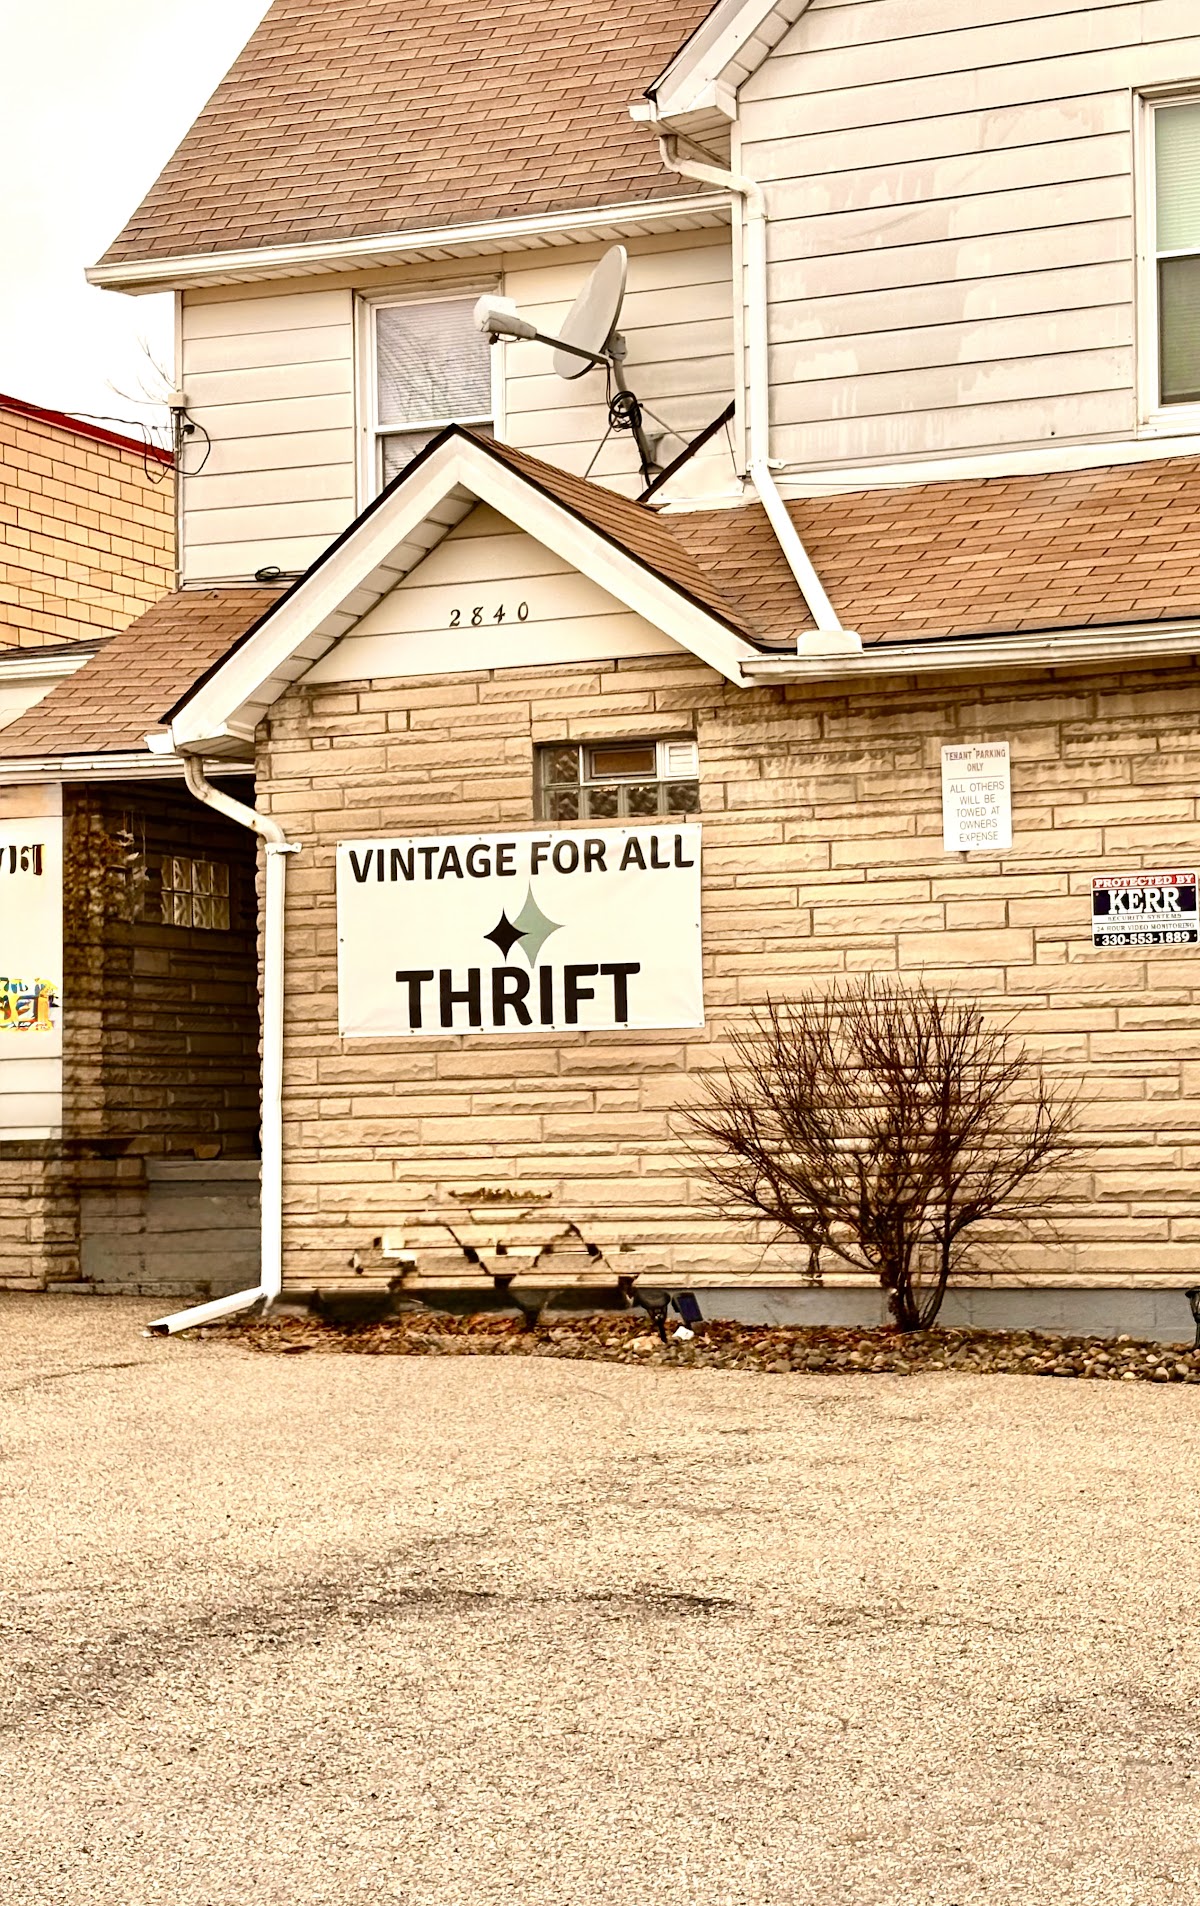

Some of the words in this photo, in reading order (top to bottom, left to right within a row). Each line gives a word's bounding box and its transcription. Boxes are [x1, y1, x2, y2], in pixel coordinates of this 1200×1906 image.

[449, 601, 529, 627] 2840
[945, 751, 972, 761] TENANT
[976, 749, 1006, 759] PARKING
[967, 763, 984, 772] ONLY
[950, 784, 965, 793] ALL
[970, 781, 1005, 792] OTHERS
[960, 796, 980, 805] WILL
[984, 794, 996, 803] BE
[956, 806, 987, 818] TOWED
[991, 805, 1000, 815] AT
[960, 819, 998, 830] OWNERS
[960, 831, 998, 842] EXPENSE
[349, 843, 517, 883] VINTAGE
[531, 839, 607, 876] FOR
[620, 834, 695, 871] ALL
[1095, 876, 1172, 888] PROTECTED
[1176, 875, 1193, 884] BY
[1108, 887, 1181, 914] KERR
[1150, 922, 1195, 930] MONITORING
[1102, 931, 1190, 946] 330-553-1889
[396, 962, 640, 1028] THRIFT
